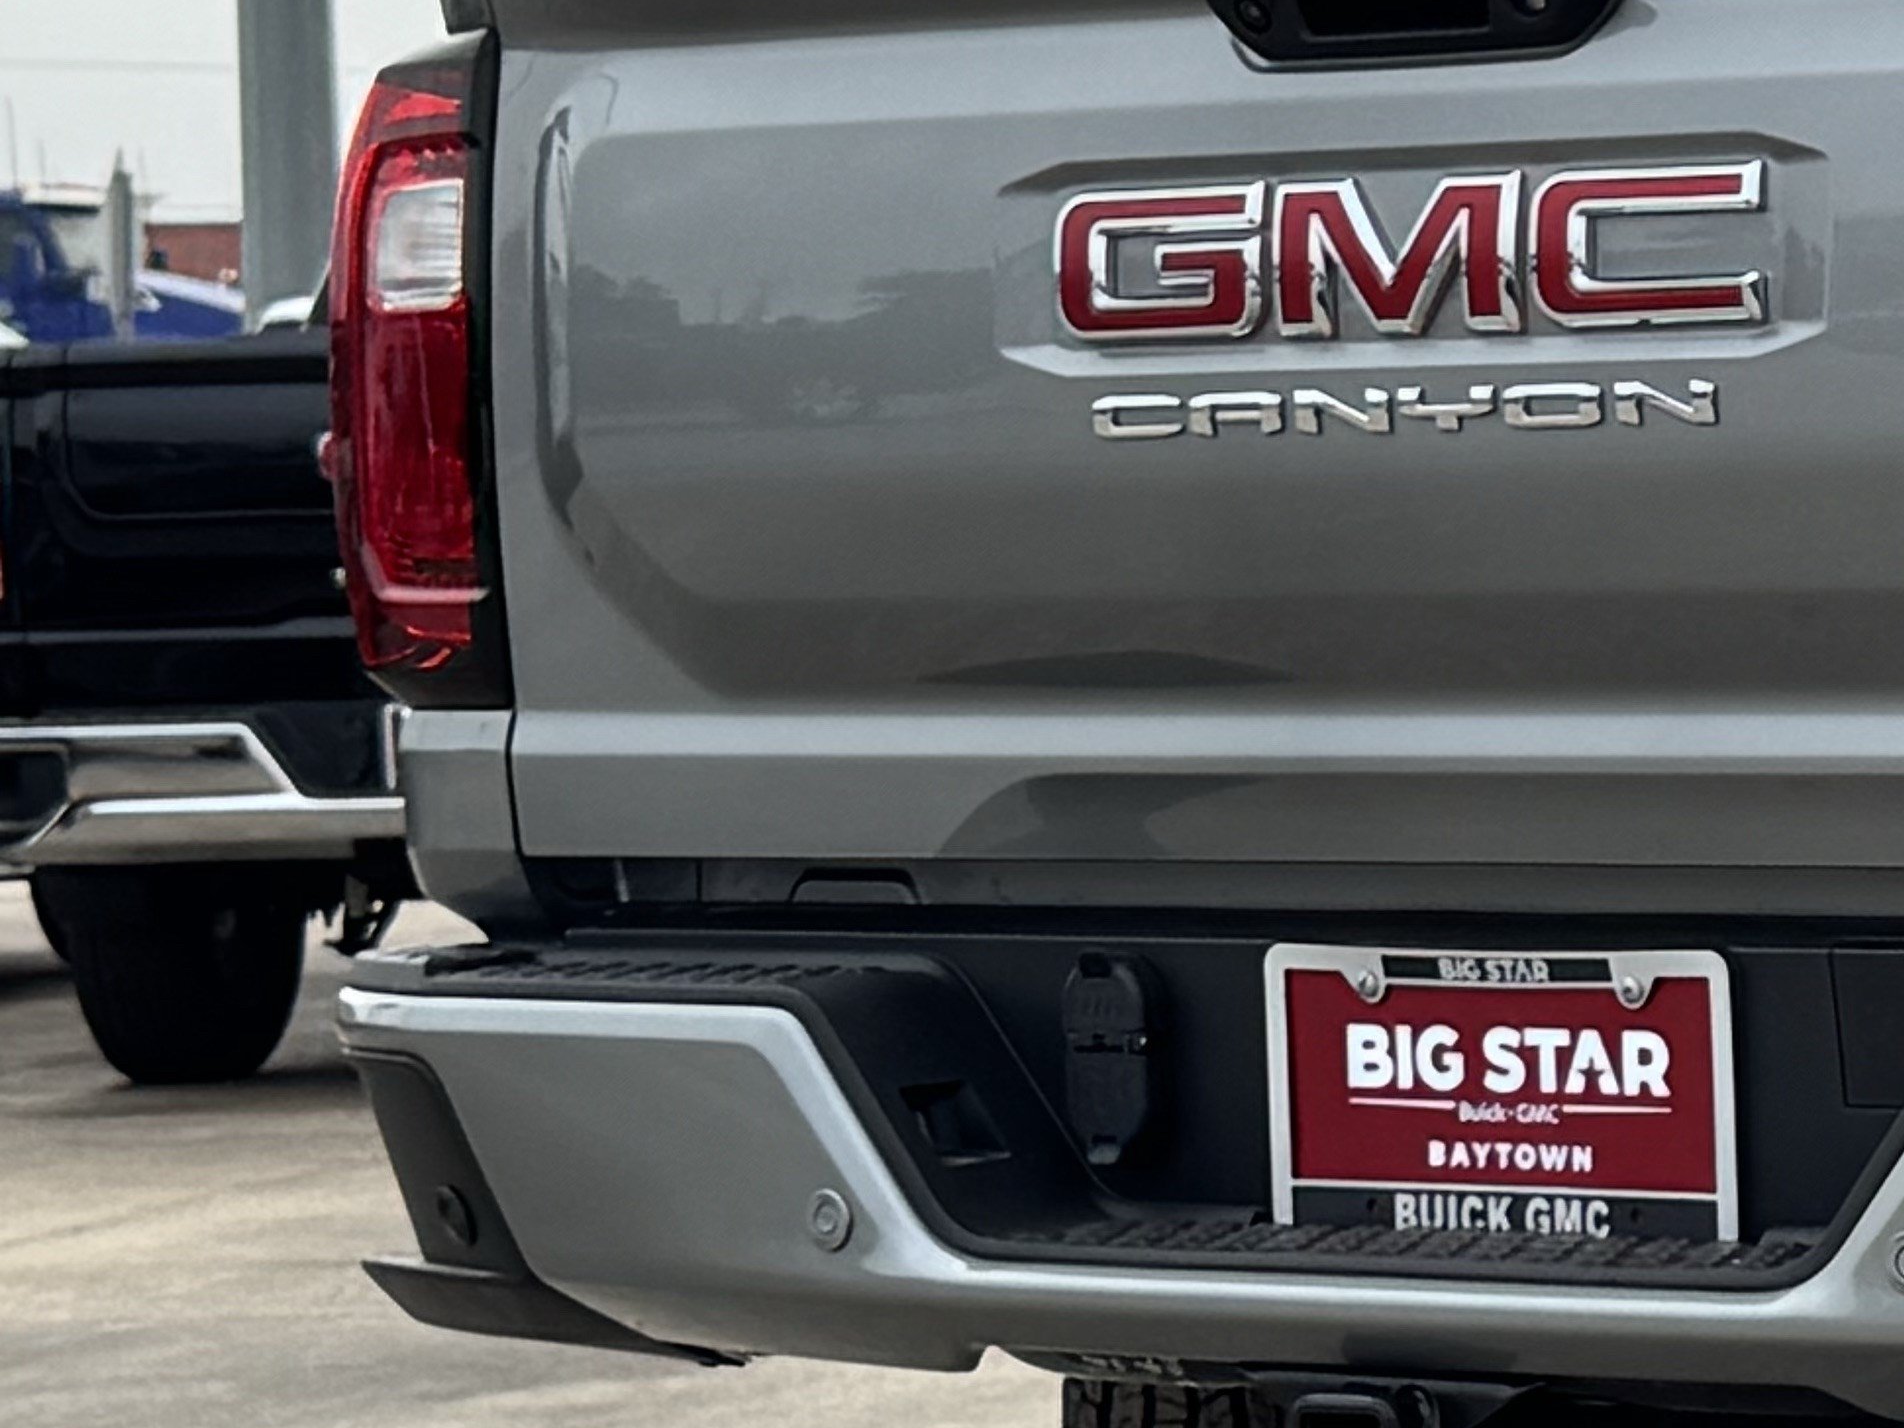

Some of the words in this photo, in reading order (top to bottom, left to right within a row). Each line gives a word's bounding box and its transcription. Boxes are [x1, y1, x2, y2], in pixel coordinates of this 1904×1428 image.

[1054, 160, 1769, 340] GMC
[1091, 378, 1720, 440] CANYON
[1437, 957, 1481, 982] BIG
[1485, 958, 1550, 983] STAR
[1345, 1023, 1465, 1092] BIG
[1482, 1027, 1672, 1098] STAR
[1427, 1140, 1593, 1172] BAYTOWN
[1394, 1193, 1512, 1234] BUICK
[1525, 1196, 1611, 1239] GMC
